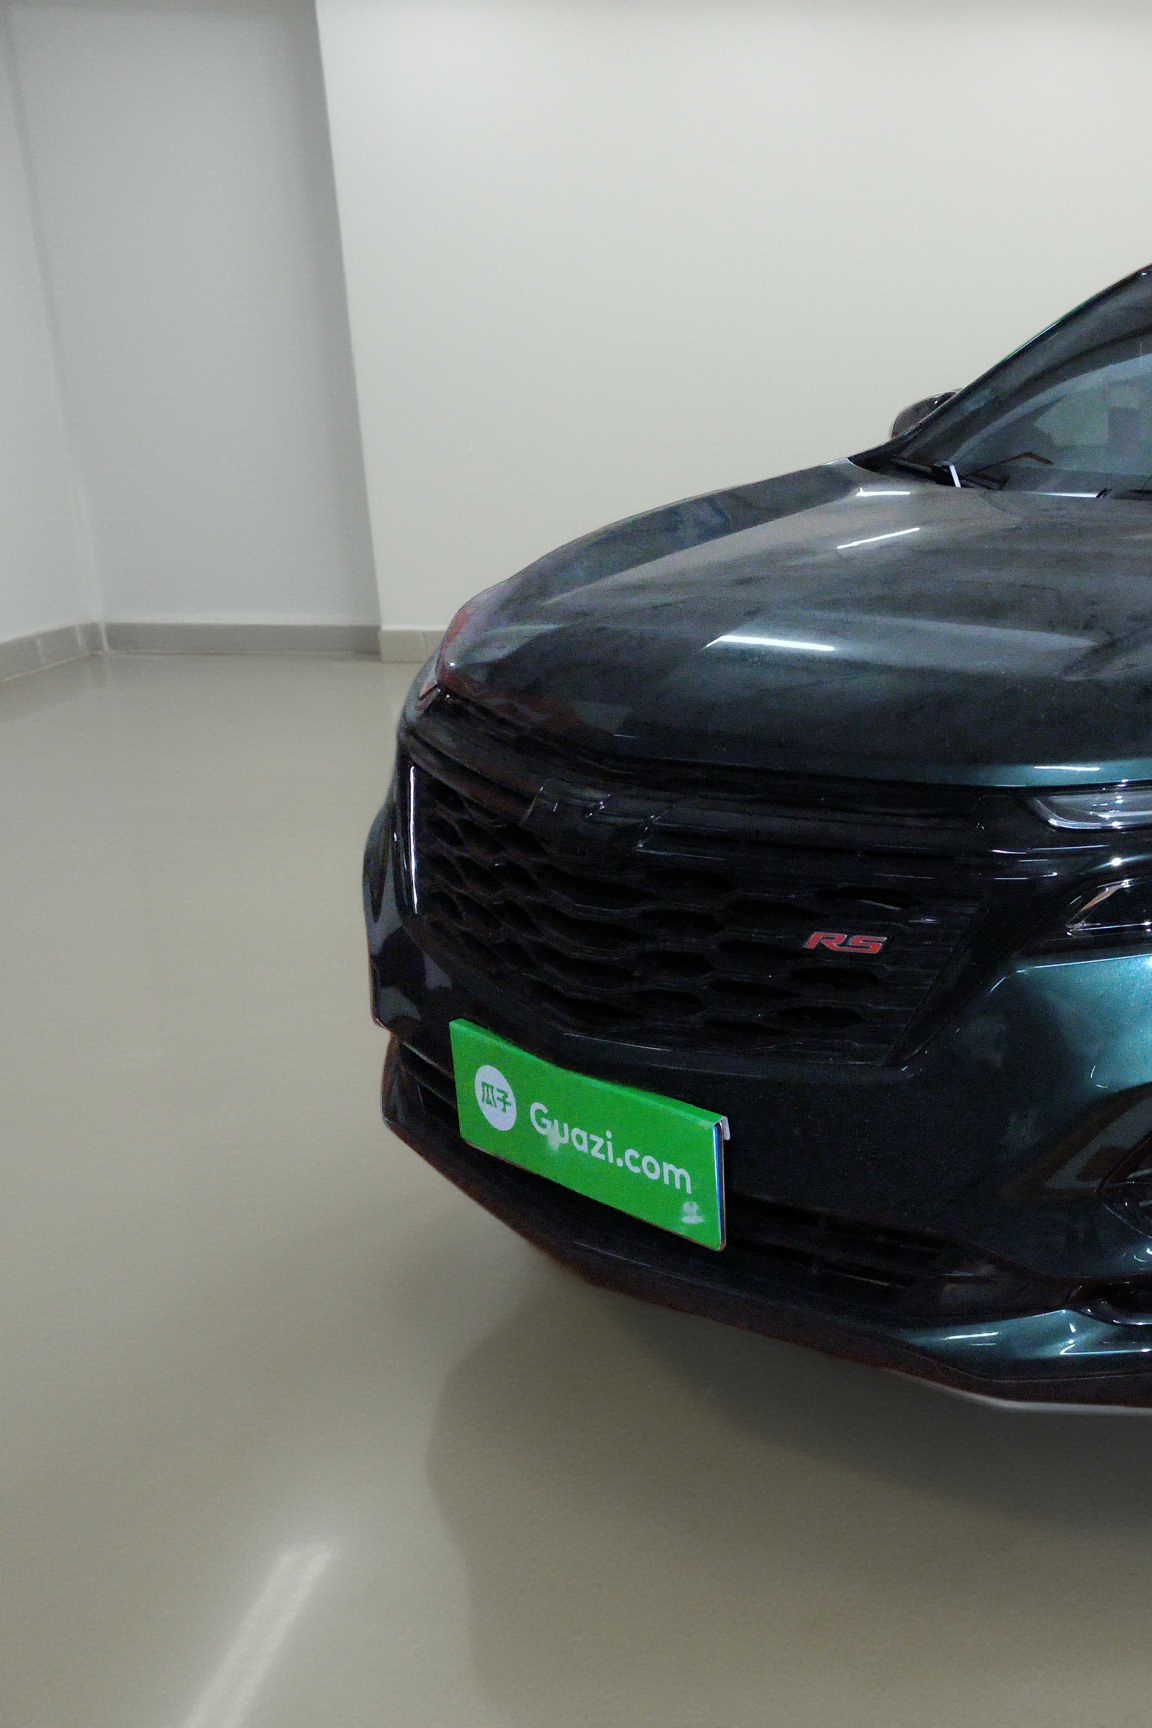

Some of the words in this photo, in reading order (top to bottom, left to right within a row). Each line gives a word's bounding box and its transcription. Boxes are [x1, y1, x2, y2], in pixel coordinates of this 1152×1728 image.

[802, 931, 887, 954] RS
[481, 1081, 511, 1113] 瓜子
[530, 1102, 692, 1194] Guazi.com
